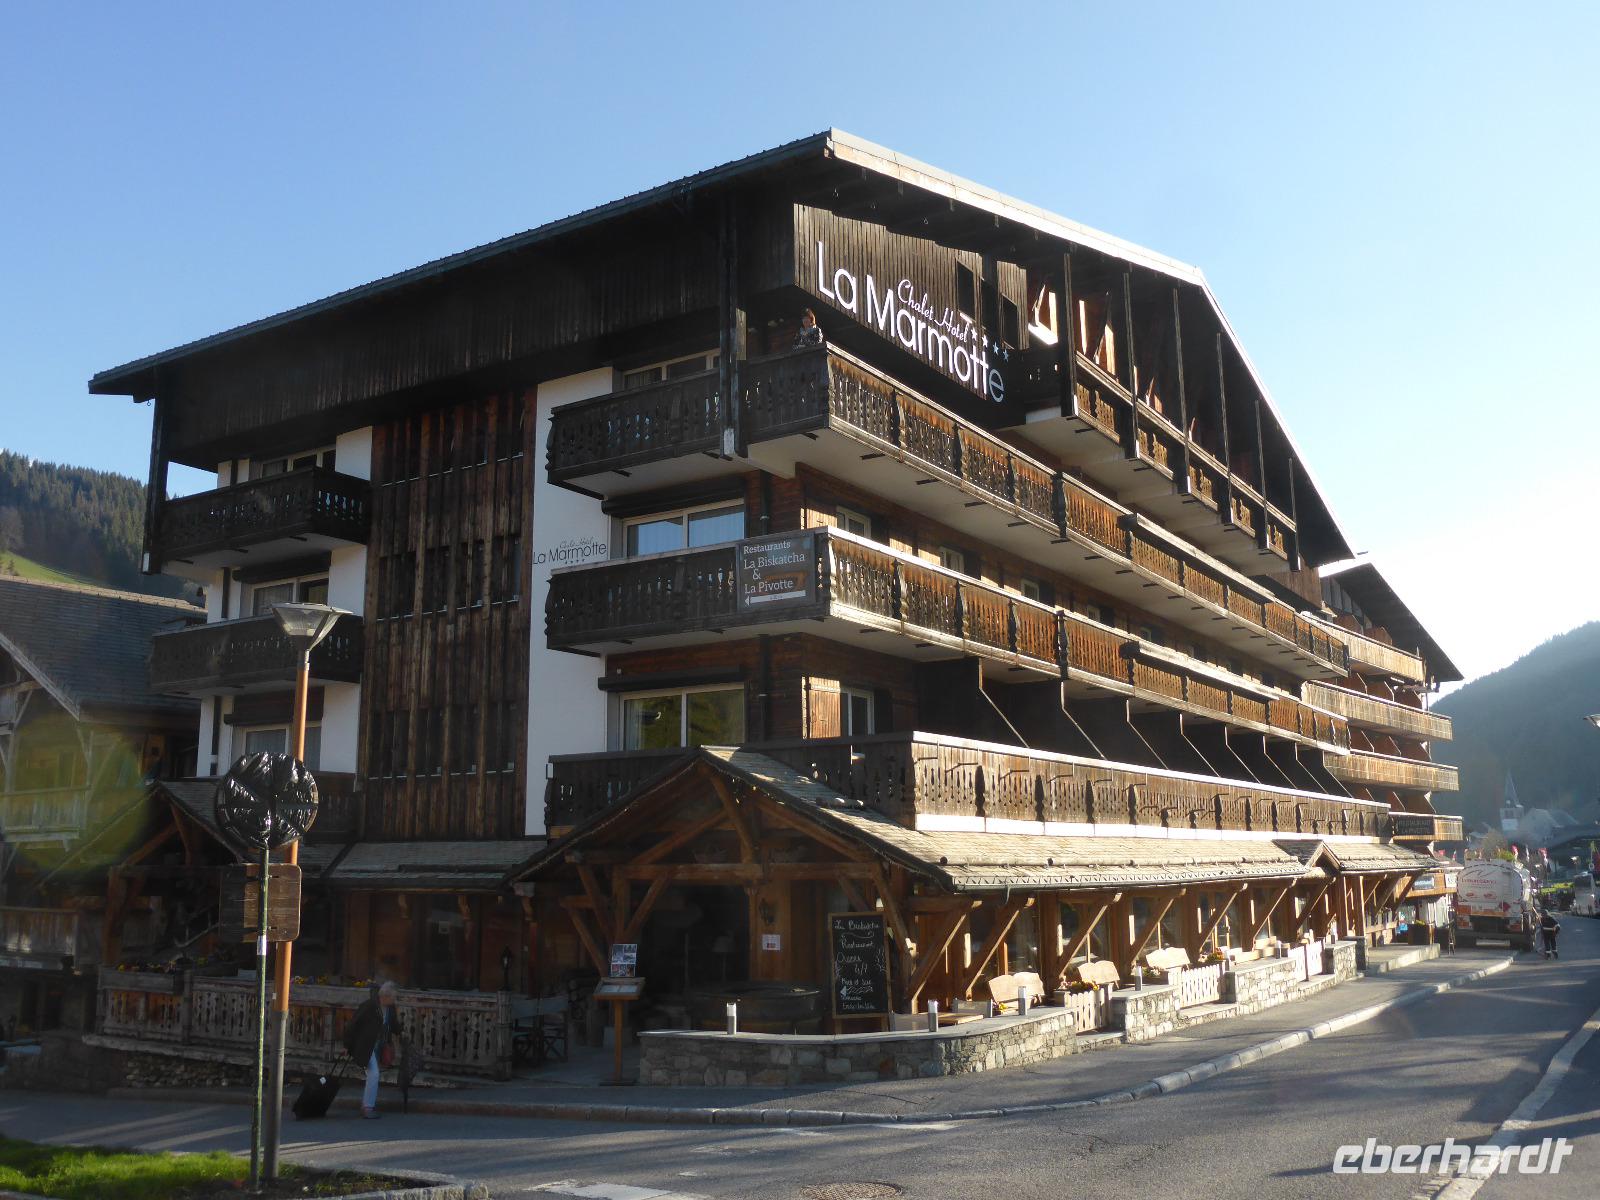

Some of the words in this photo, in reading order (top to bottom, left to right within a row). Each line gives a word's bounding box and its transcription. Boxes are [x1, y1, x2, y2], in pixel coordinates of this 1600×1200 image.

[897, 279, 934, 320] Chalet
[816, 240, 857, 314] La
[866, 274, 1004, 403] Marmotte
[533, 551, 546, 565] La
[548, 541, 607, 562] Marmotte
[743, 540, 791, 555] Restaurants
[743, 559, 756, 570] La
[757, 552, 806, 568] Biskatcha
[752, 568, 761, 580] &
[744, 583, 756, 594] La
[758, 580, 794, 593] Pivotte
